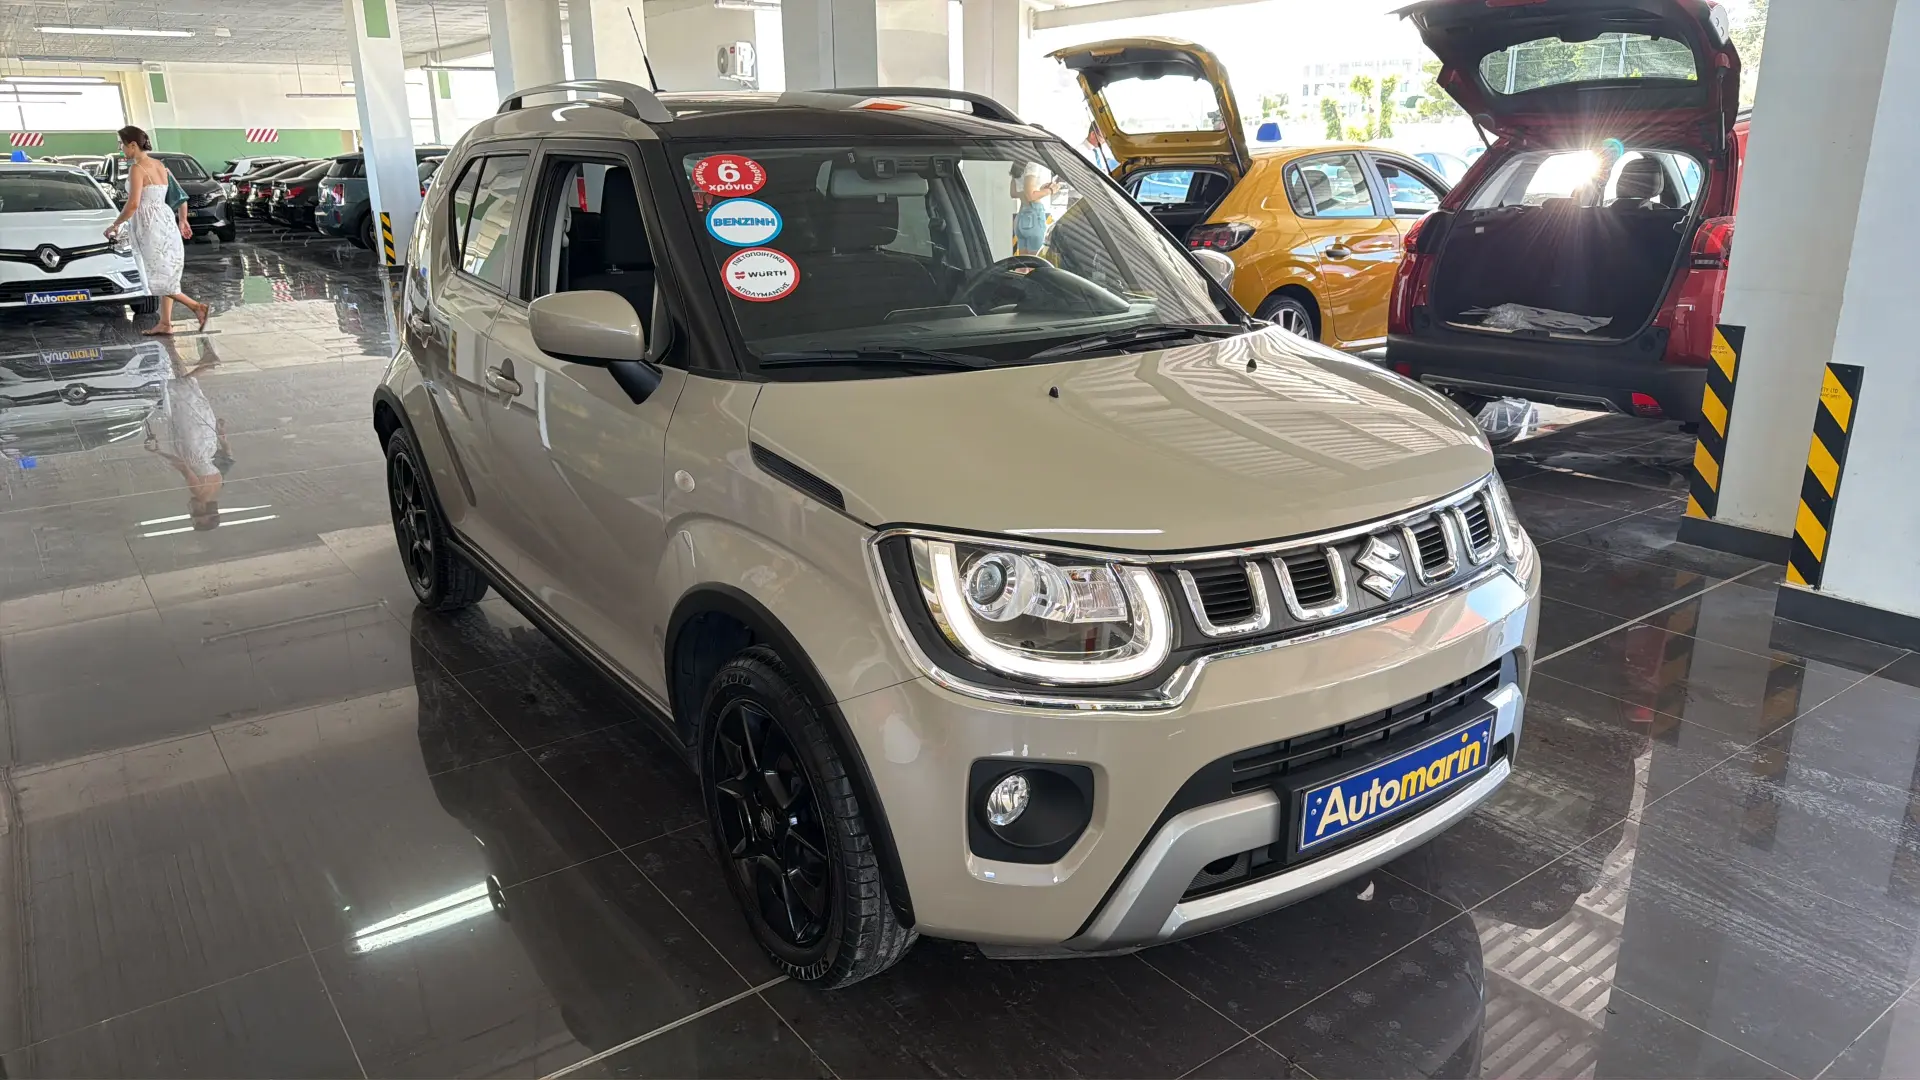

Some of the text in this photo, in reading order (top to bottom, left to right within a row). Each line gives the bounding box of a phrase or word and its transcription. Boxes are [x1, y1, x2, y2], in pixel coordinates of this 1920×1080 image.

[695, 162, 708, 185] service
[718, 163, 740, 183] 6
[708, 182, 753, 192] χρόνια
[30, 291, 87, 304] Automarin
[1315, 732, 1481, 836] Automarin
